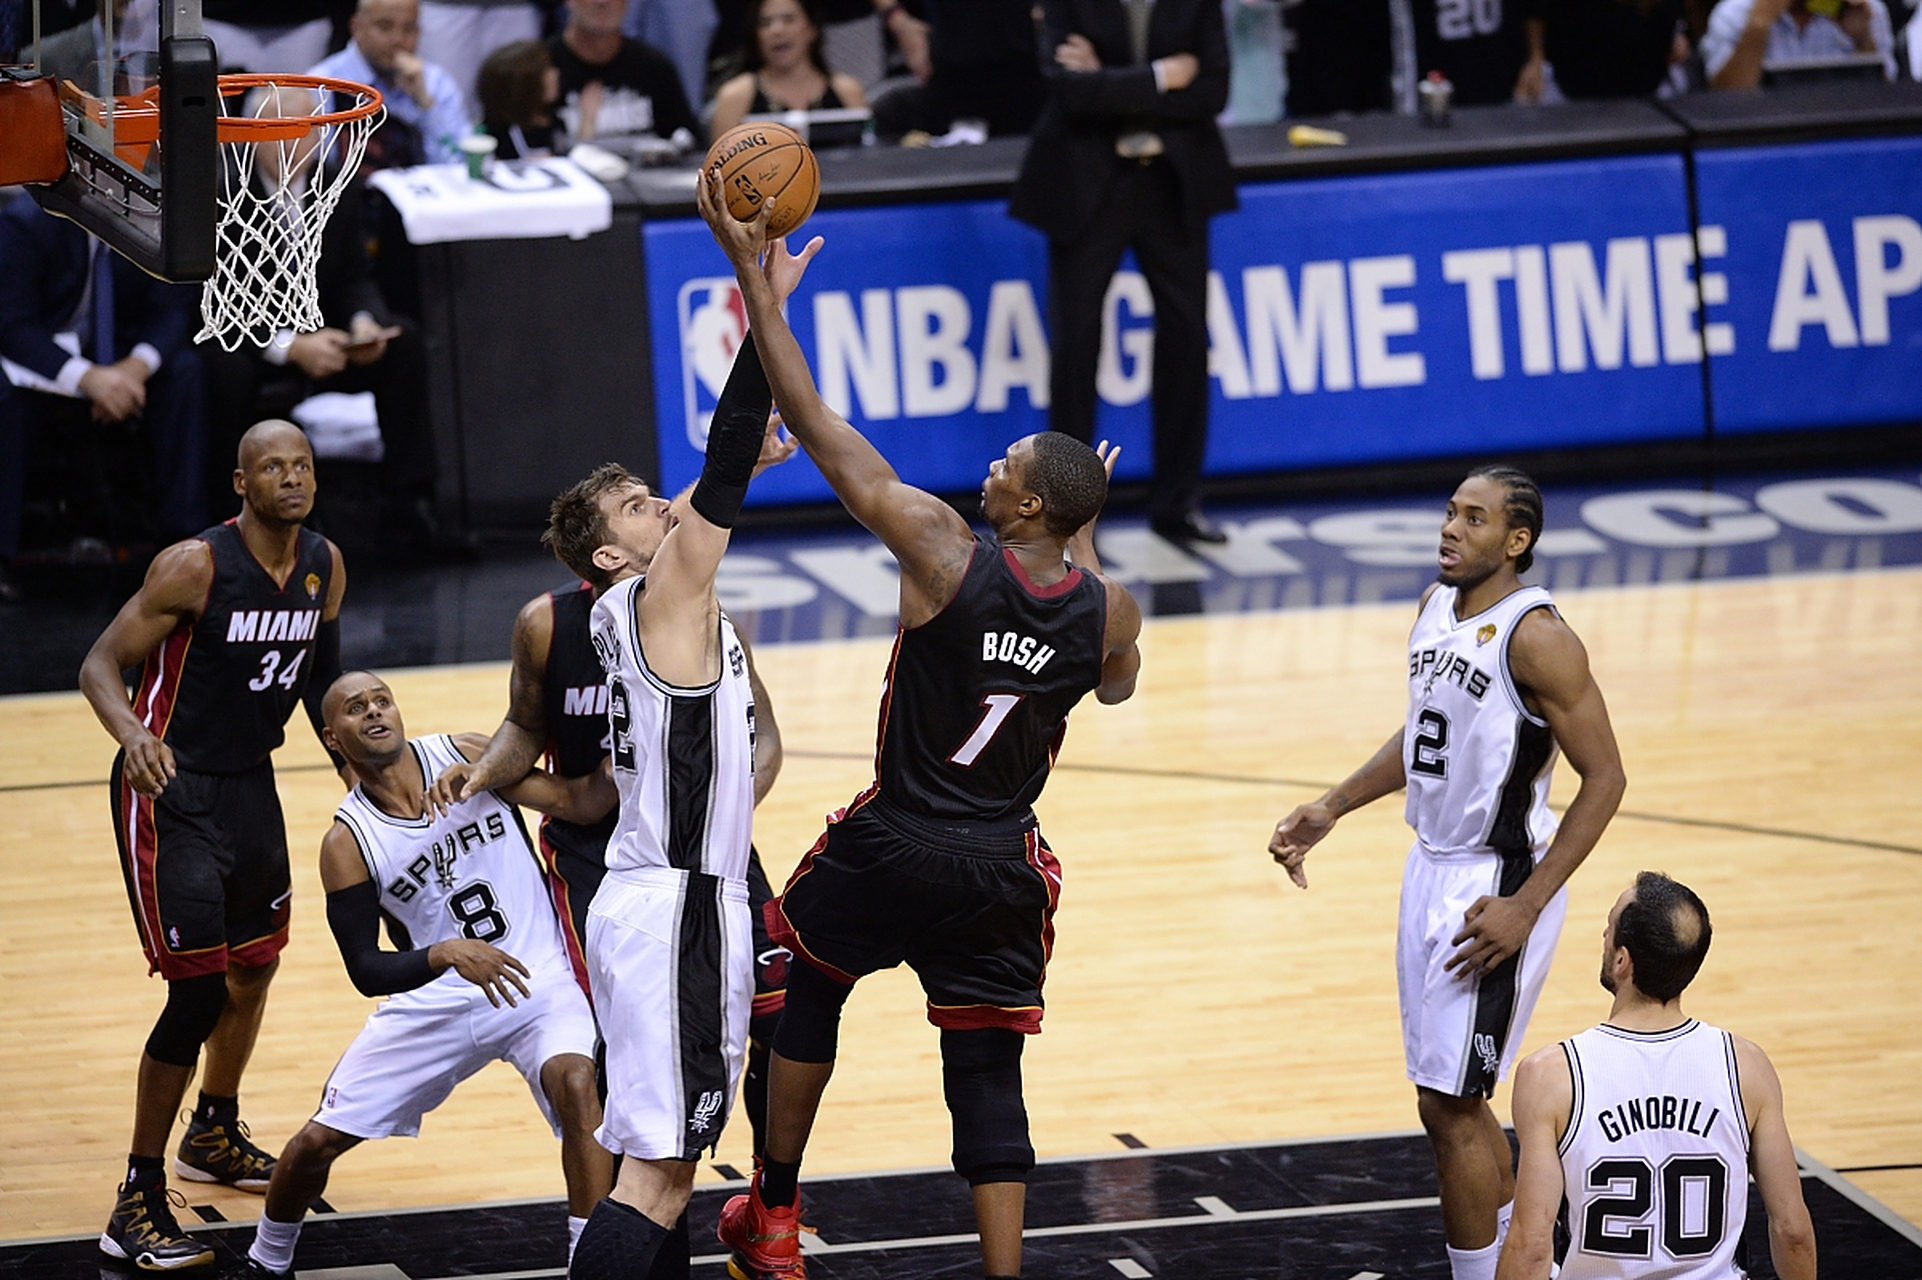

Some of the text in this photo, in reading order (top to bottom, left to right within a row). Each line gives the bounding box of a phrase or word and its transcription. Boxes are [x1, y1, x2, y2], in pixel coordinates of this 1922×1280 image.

[1437, 0, 1501, 40] 20
[814, 215, 1922, 421] NBA GAME TIME AP
[226, 609, 321, 642] MIAMI
[982, 631, 1057, 675] BOSH
[248, 648, 307, 691] 34
[1409, 648, 1493, 703] SPURS
[564, 685, 611, 716] MI
[947, 692, 1025, 768] 1
[1410, 705, 1451, 781] 2
[387, 812, 506, 903] SPURS
[445, 879, 511, 944] 8
[1597, 1095, 1720, 1143] GINOBILI
[1580, 1154, 1730, 1261] 20
